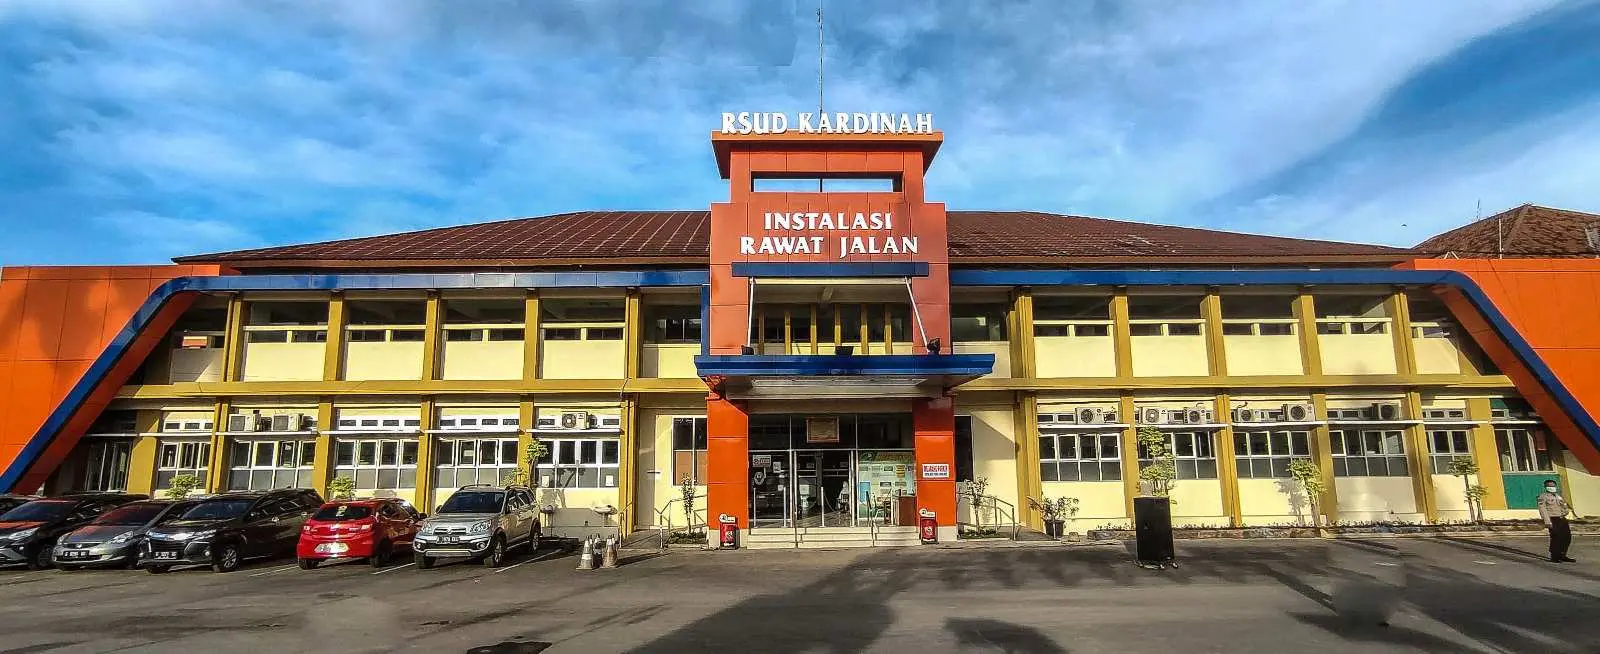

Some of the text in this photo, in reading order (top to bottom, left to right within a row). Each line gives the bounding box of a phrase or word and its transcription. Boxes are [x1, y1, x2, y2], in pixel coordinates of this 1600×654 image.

[721, 111, 933, 135] RSUD KARDINAH
[764, 212, 892, 231] INSTALASI
[740, 236, 918, 259] RAWAT JALAN
